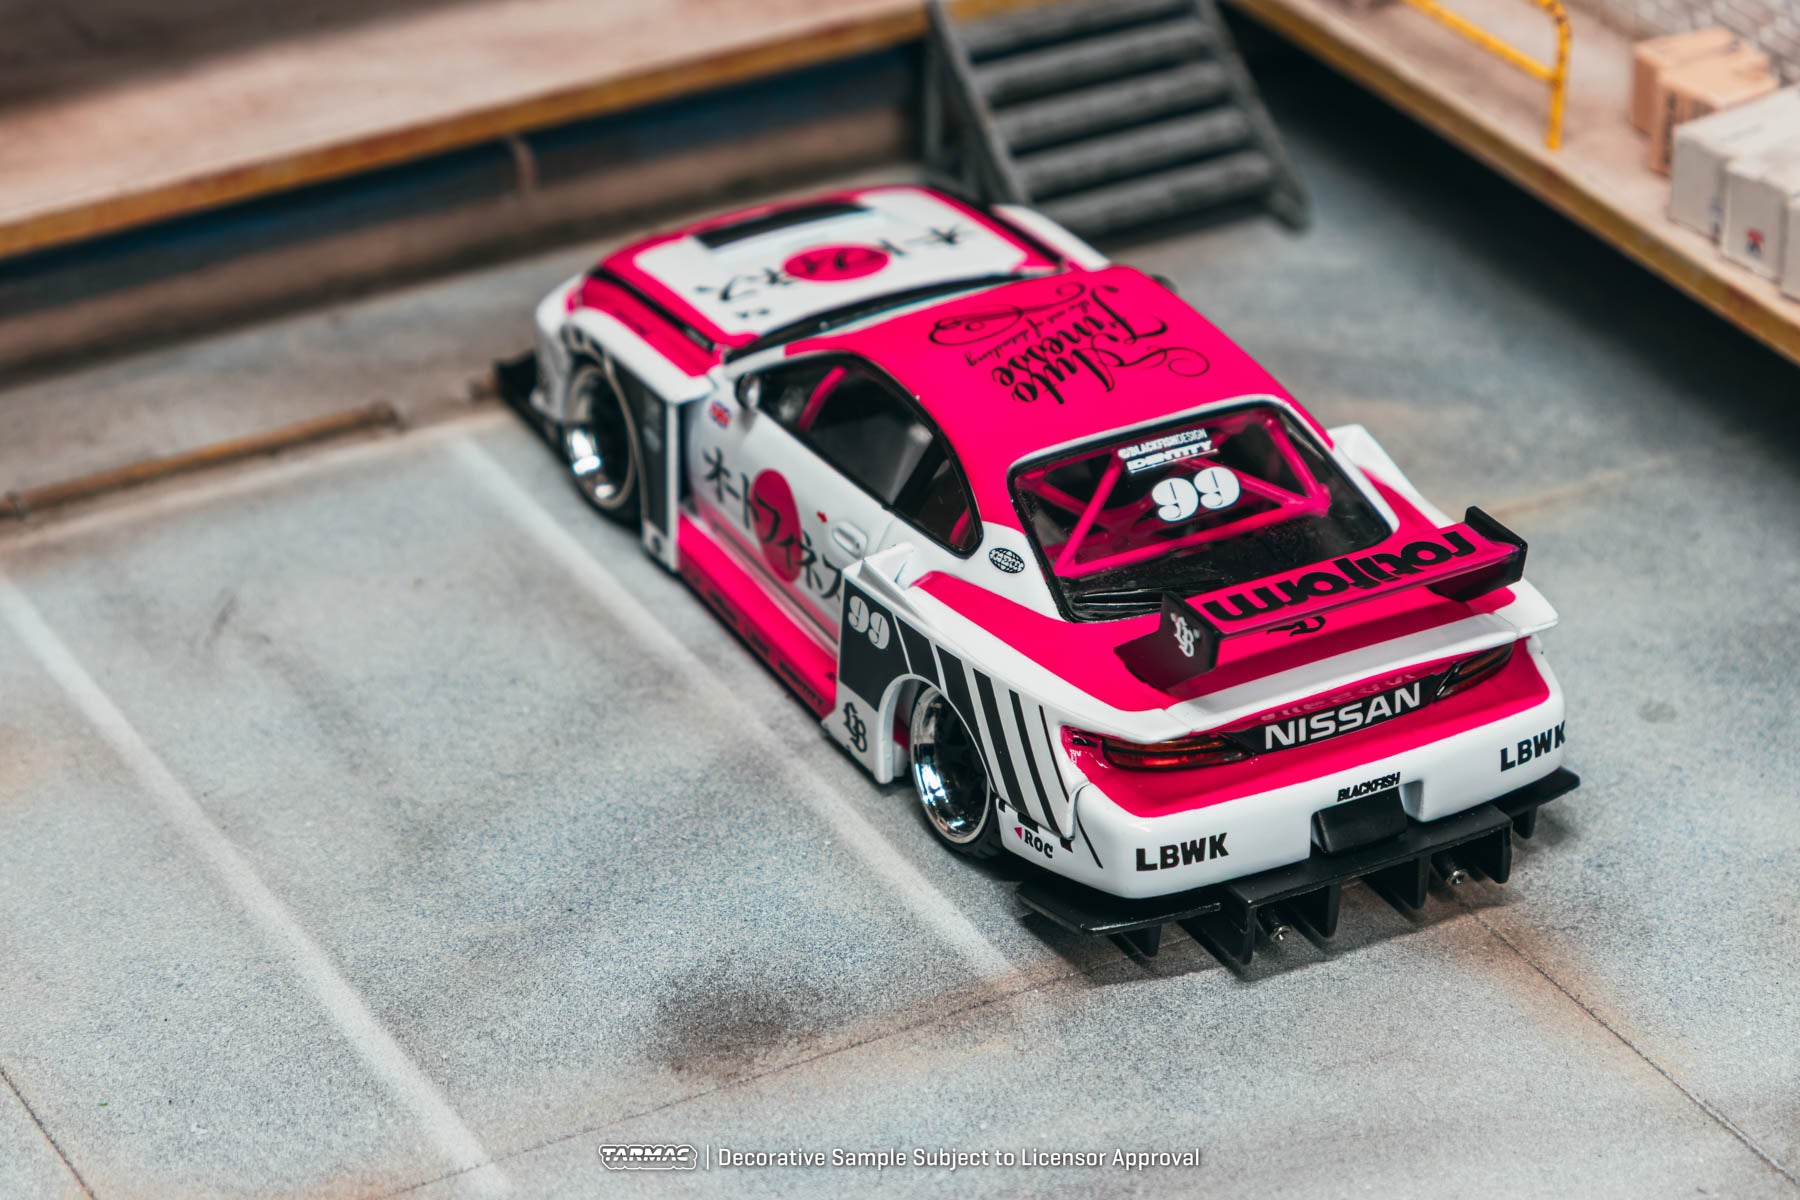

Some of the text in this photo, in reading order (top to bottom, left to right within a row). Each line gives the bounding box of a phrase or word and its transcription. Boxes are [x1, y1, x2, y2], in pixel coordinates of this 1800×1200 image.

[991, 284, 1168, 387] Finesse
[1151, 466, 1240, 522] 99
[1202, 531, 1477, 621] rotiform
[848, 595, 890, 650] 99
[1264, 682, 1421, 751] NISSAN
[1499, 719, 1567, 773] LBWK
[1336, 772, 1401, 803] BLACKFISH
[1024, 828, 1054, 859] ROC
[1136, 832, 1229, 872] LBWK
